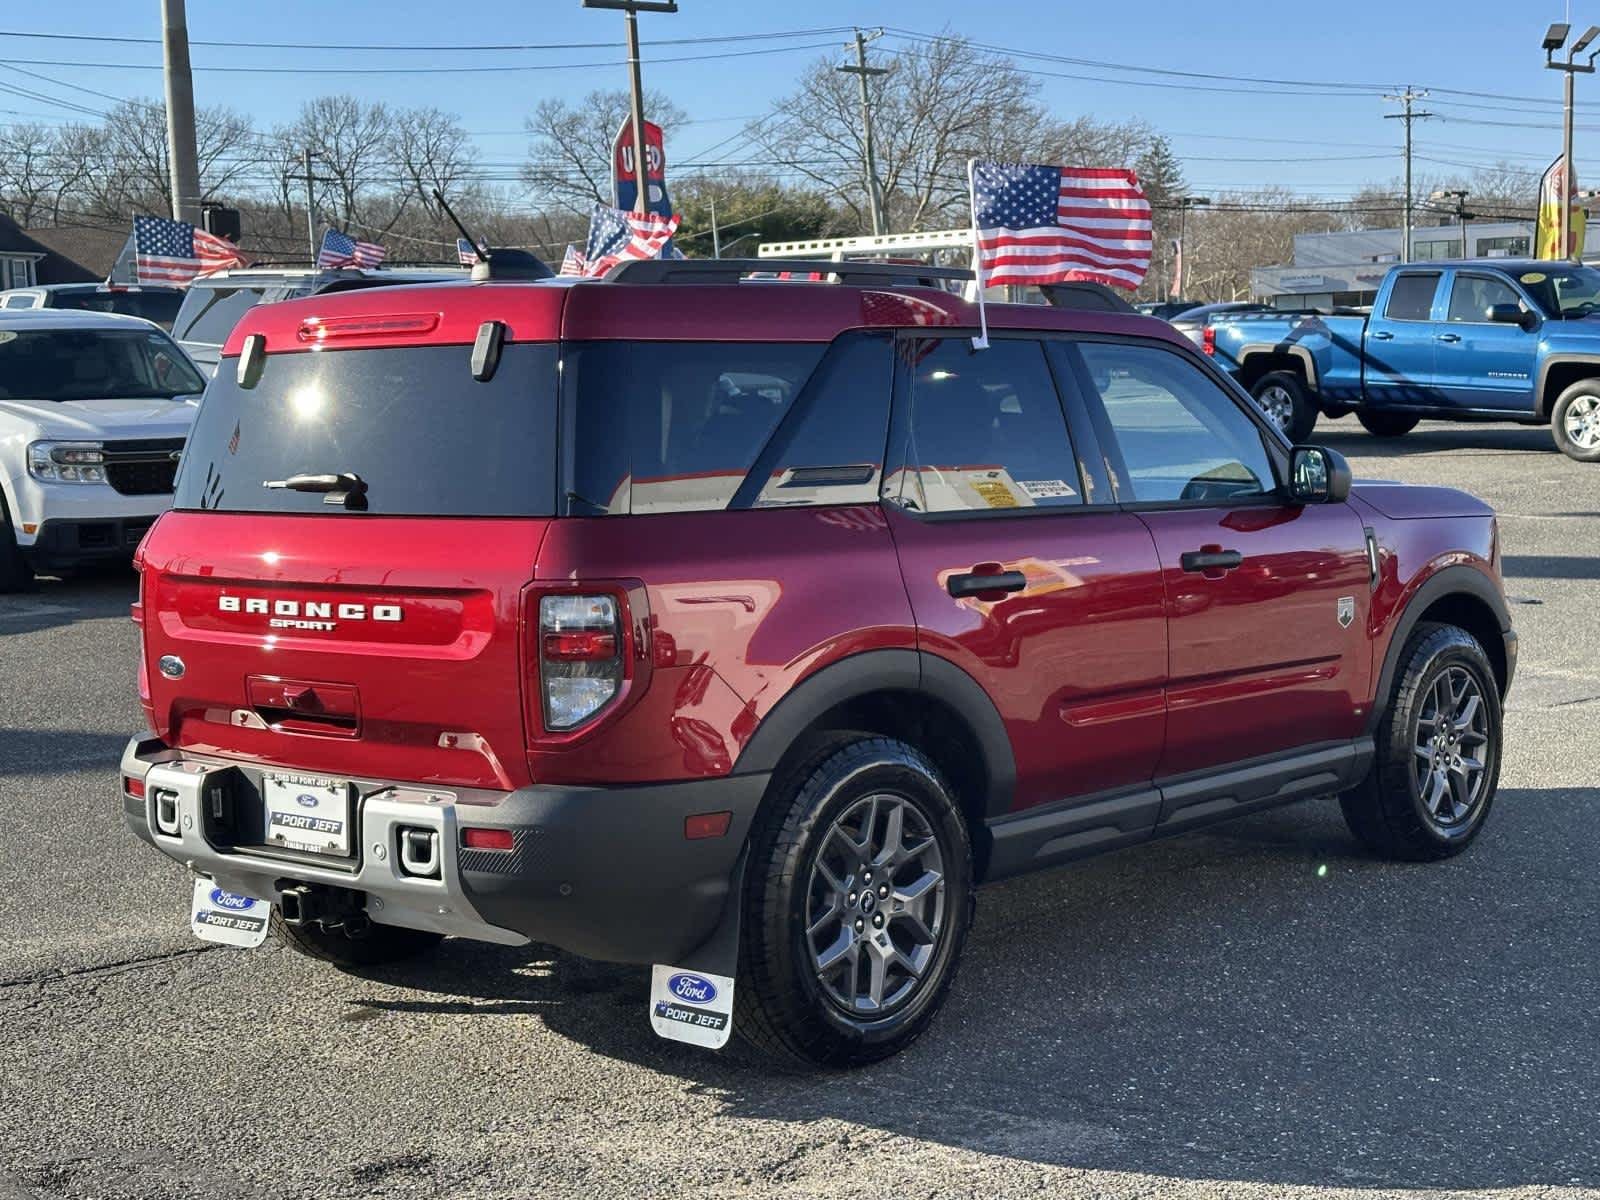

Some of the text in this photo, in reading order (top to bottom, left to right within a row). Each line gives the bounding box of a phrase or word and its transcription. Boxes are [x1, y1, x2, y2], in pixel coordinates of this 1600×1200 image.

[219, 596, 402, 621] BRONCO
[270, 619, 337, 630] SPORT
[282, 814, 339, 833] PORT JEFF
[217, 890, 247, 908] Ford
[206, 914, 260, 931] PORT JEFF
[676, 976, 708, 1000] Ford
[665, 1007, 723, 1028] PORT JEFF
